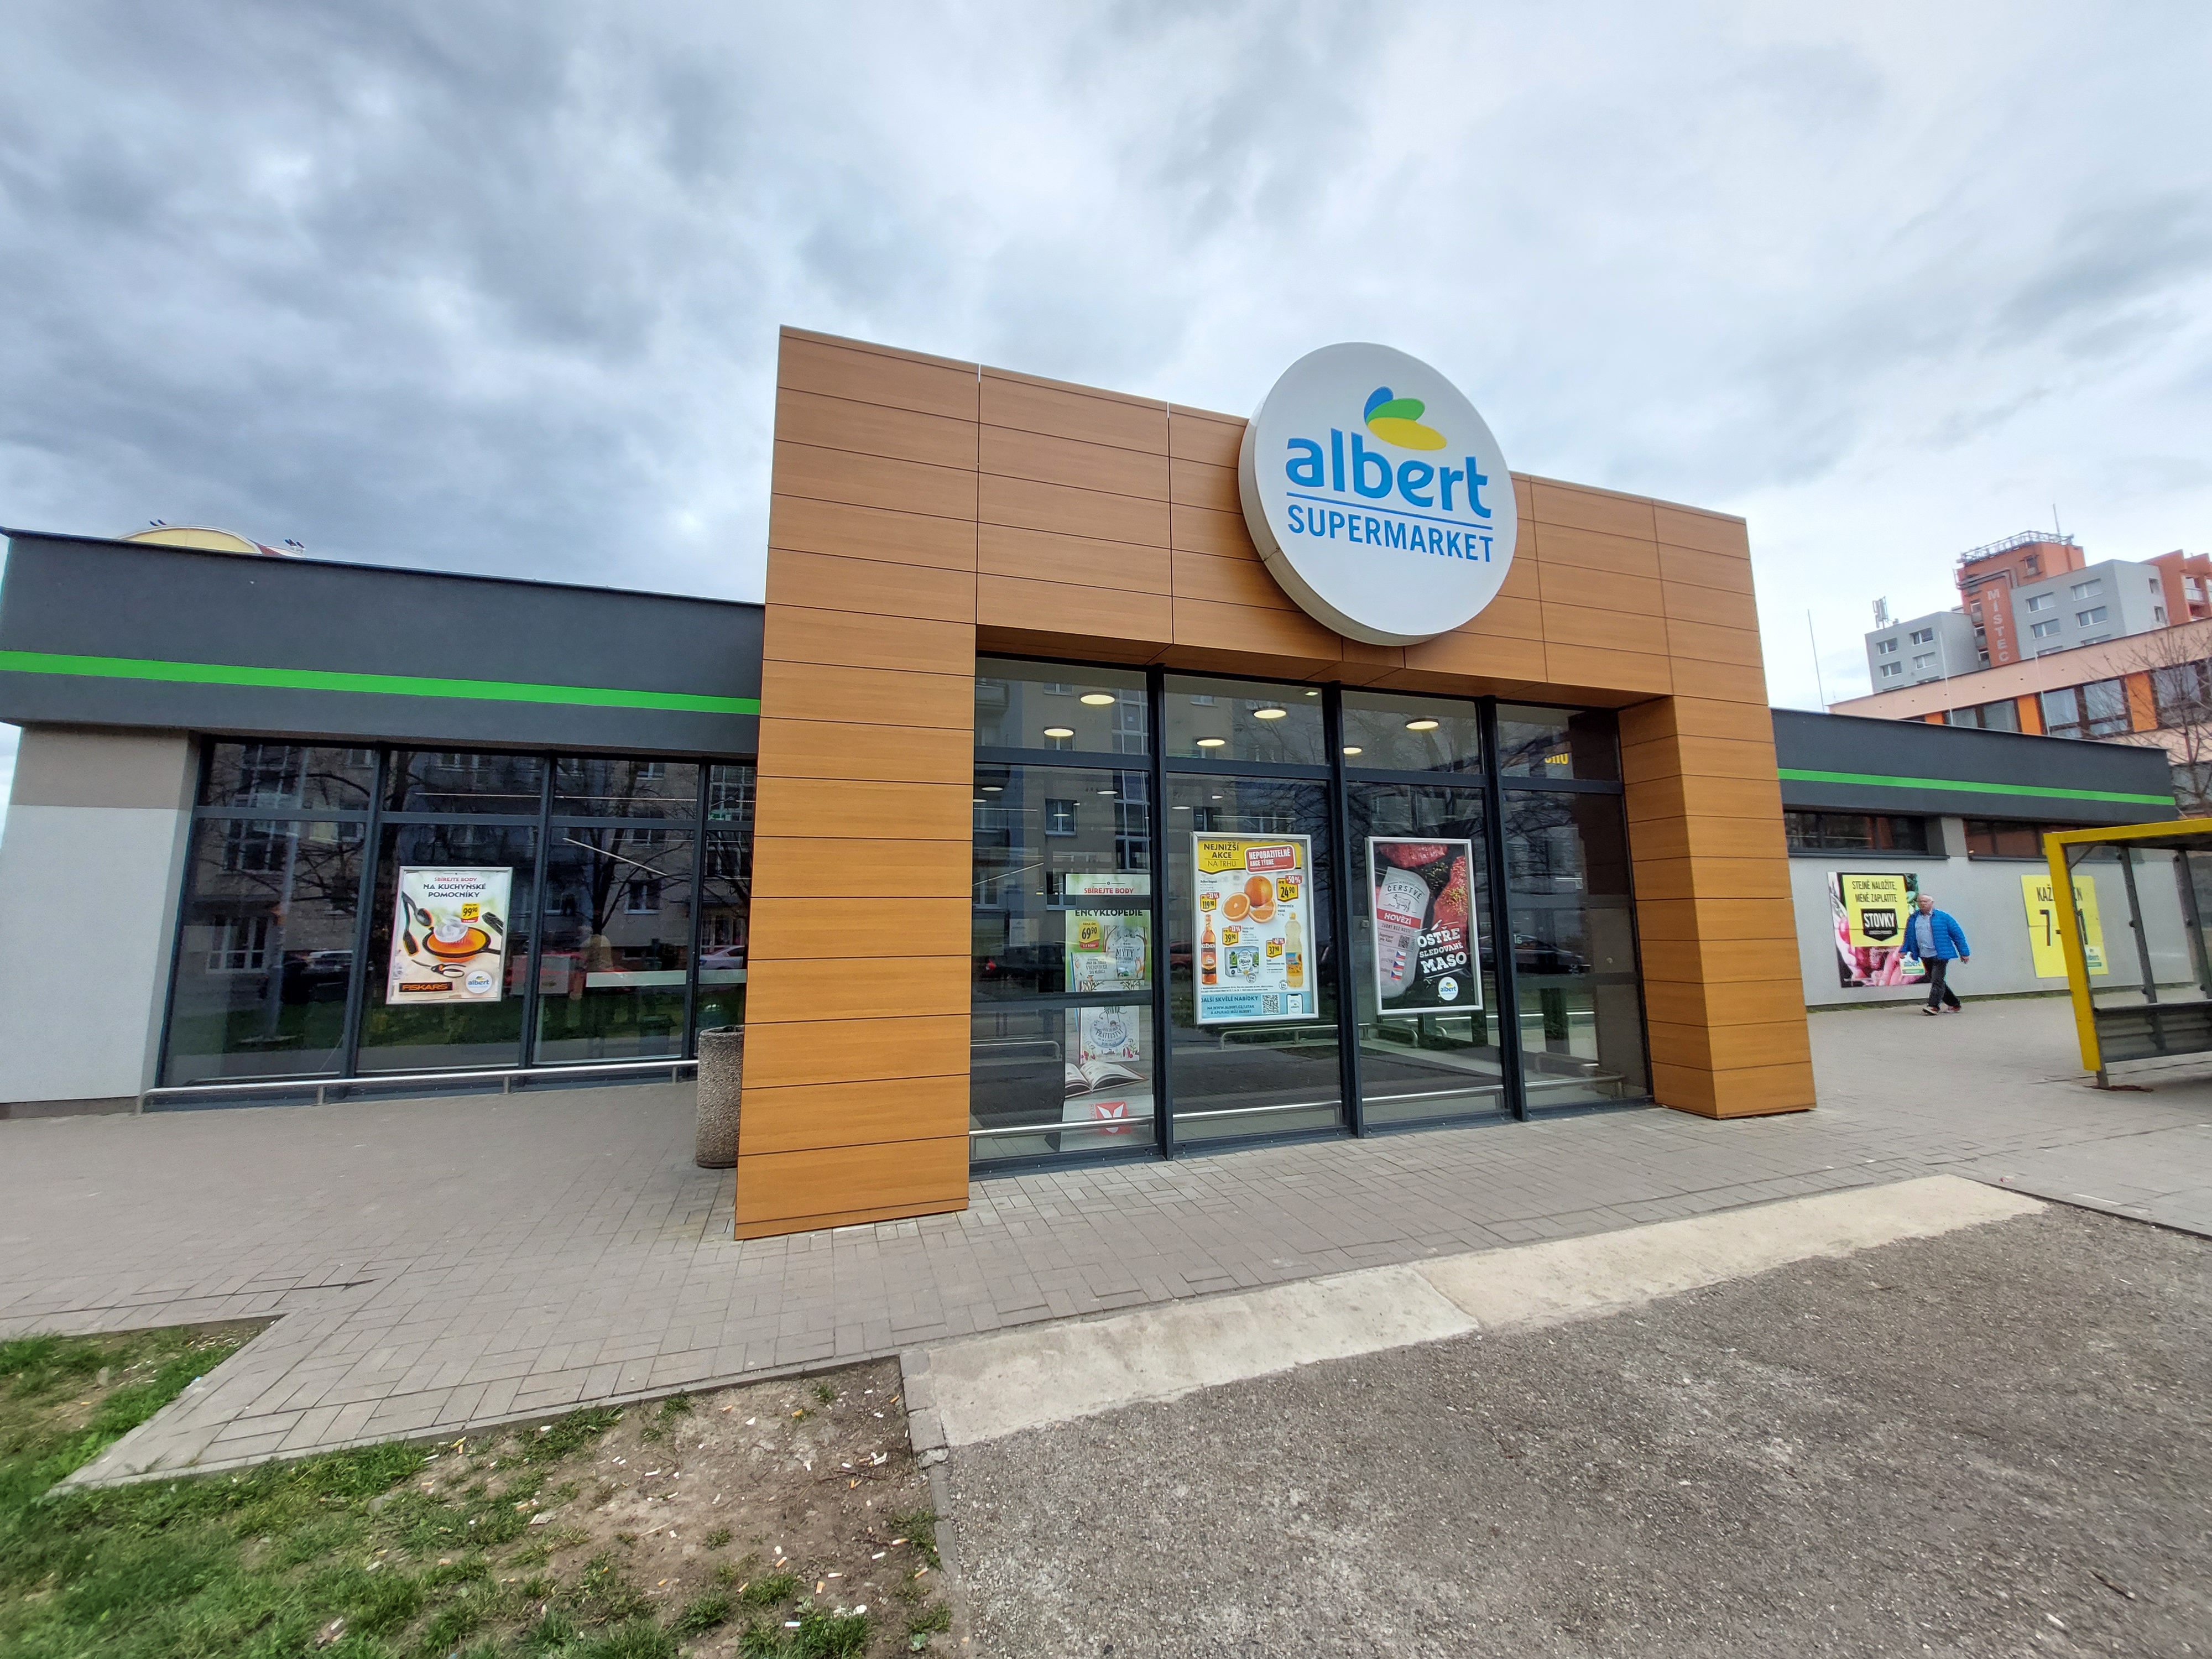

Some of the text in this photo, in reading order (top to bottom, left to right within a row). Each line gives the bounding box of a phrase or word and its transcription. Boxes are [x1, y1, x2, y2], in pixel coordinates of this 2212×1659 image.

[1285, 427, 1491, 518] albert
[1287, 504, 1494, 562] SUPERMARKET
[1203, 842, 1239, 851] NEJNIŽŠÍ
[1249, 847, 1291, 860] NEPORAZITELNÉ
[1387, 885, 1422, 899] ČERSTVÉ
[1852, 879, 1870, 890] STEJNĚ
[1384, 912, 1412, 925] HOVĚZÍ
[1864, 912, 1895, 927] STOVKY
[1417, 926, 1460, 947] OSTŘE
[1419, 941, 1464, 958] SLEDOVANÉ
[1420, 951, 1467, 973] MASO
